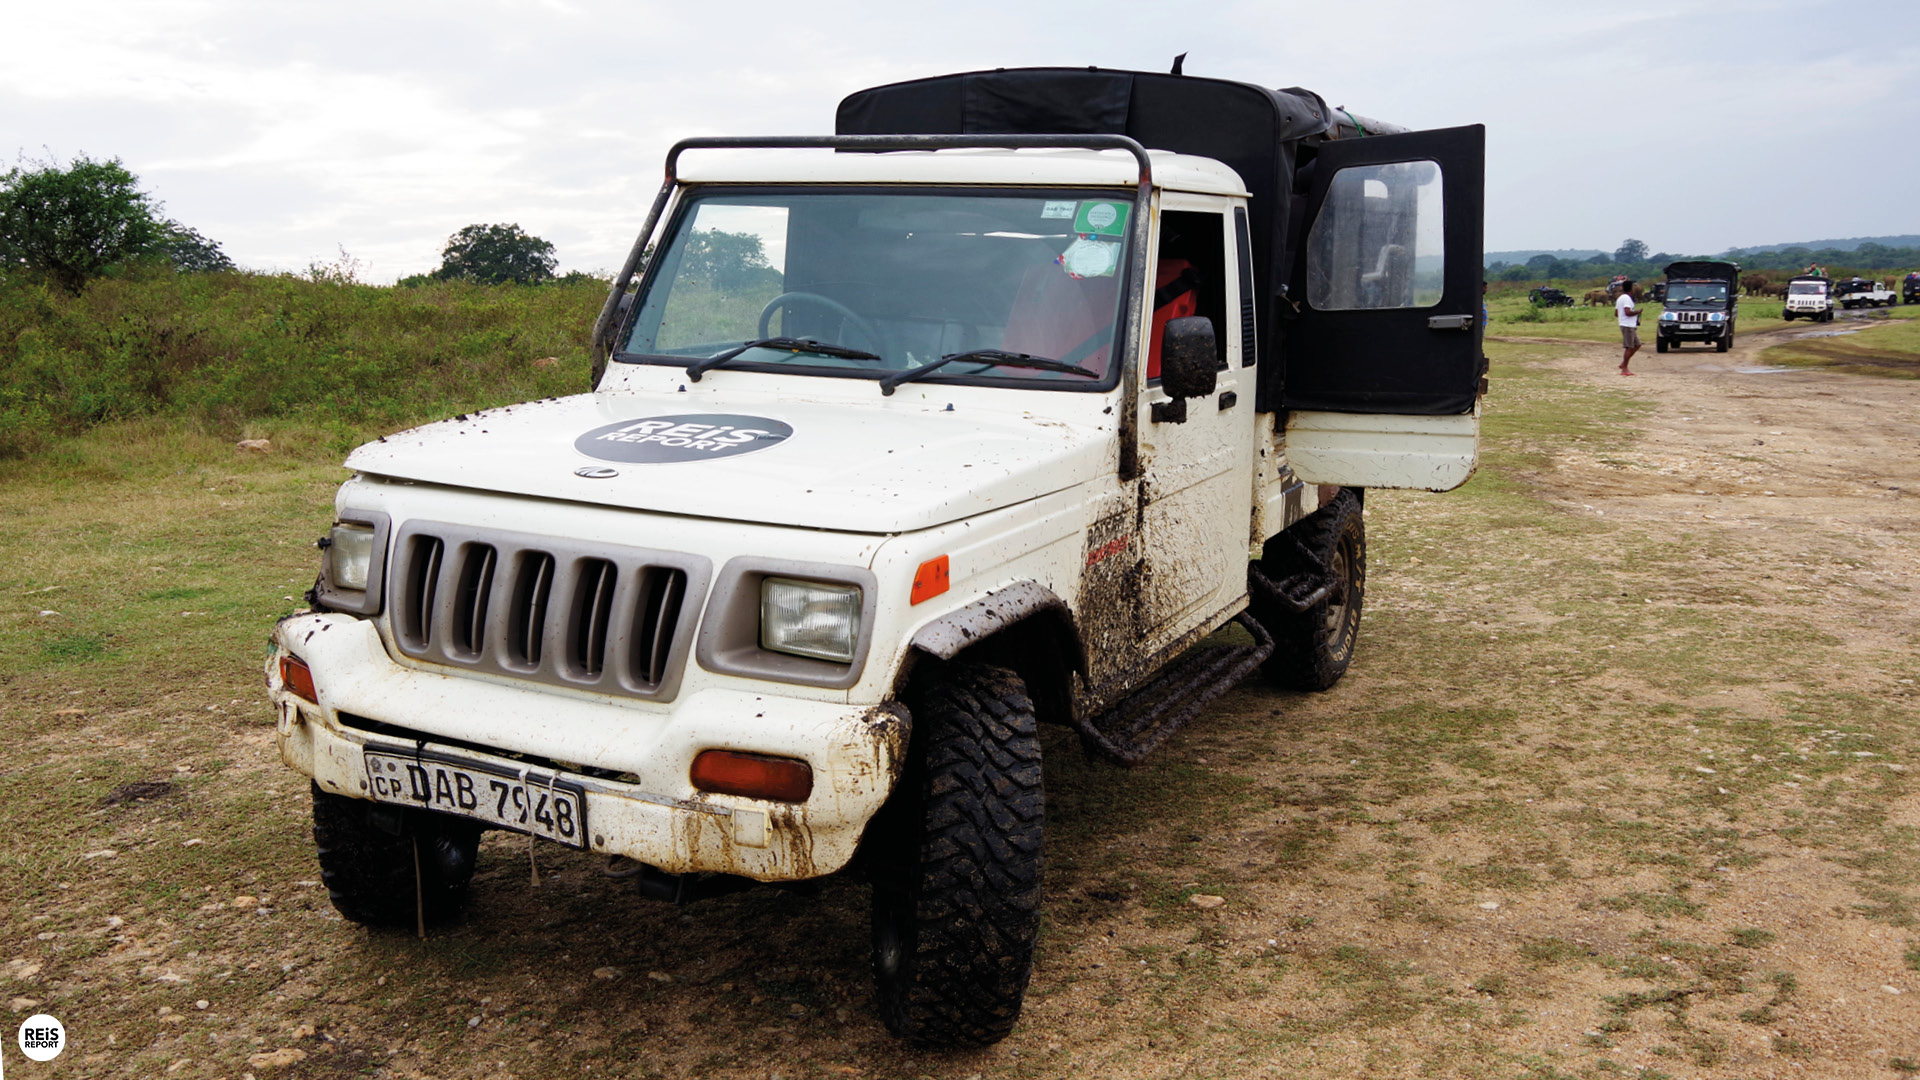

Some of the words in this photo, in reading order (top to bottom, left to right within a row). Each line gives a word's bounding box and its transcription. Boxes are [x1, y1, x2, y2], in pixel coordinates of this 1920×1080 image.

[596, 432, 739, 452] REPORT
[620, 421, 769, 443] REiS
[375, 776, 401, 798] CP
[406, 764, 478, 811] DAB
[489, 779, 575, 838] 7948
